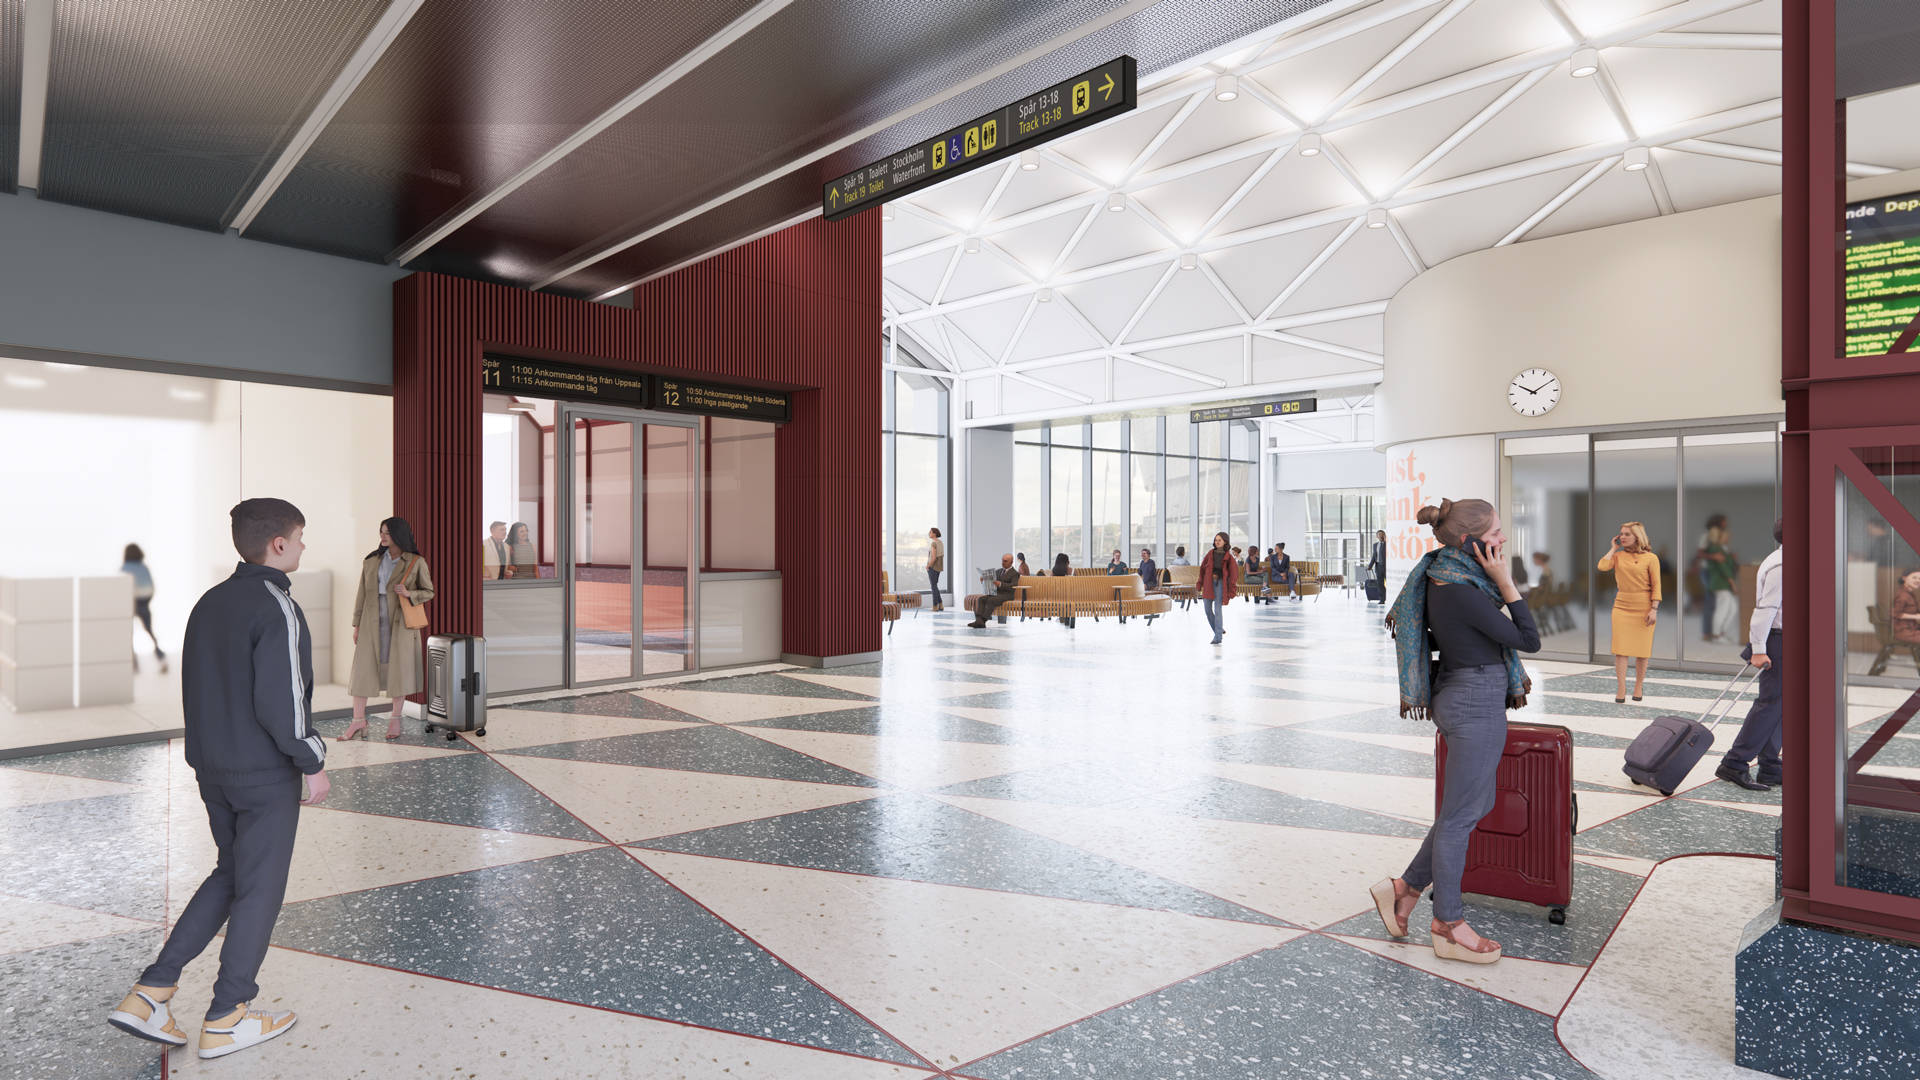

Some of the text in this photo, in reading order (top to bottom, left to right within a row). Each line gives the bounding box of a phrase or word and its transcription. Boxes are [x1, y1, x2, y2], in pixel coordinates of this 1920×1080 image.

[1019, 90, 1058, 119] Spår 13-18
[1019, 106, 1061, 134] Track 13-18
[893, 148, 924, 170] Stockholm
[869, 163, 888, 179] Toalett
[893, 163, 925, 184] Waterfront
[844, 172, 864, 191] Spår 19
[869, 179, 884, 194] Toilet
[844, 186, 865, 204] Track 19
[1885, 200, 1920, 213] Dep
[1846, 290, 1868, 299] Lund
[483, 359, 500, 368] Spår
[483, 369, 500, 386] 11
[511, 365, 641, 389] 11:00 Ankommande tåg från Uppsala
[511, 376, 598, 394] 11:15 Ankommande tåg
[664, 382, 678, 390] Spår
[664, 391, 680, 406] 12
[686, 387, 702, 396] 10:50
[704, 390, 742, 401] Ankommande
[743, 394, 752, 403] tåg
[718, 399, 748, 410] påstigande
[1387, 449, 1426, 487] ust,
